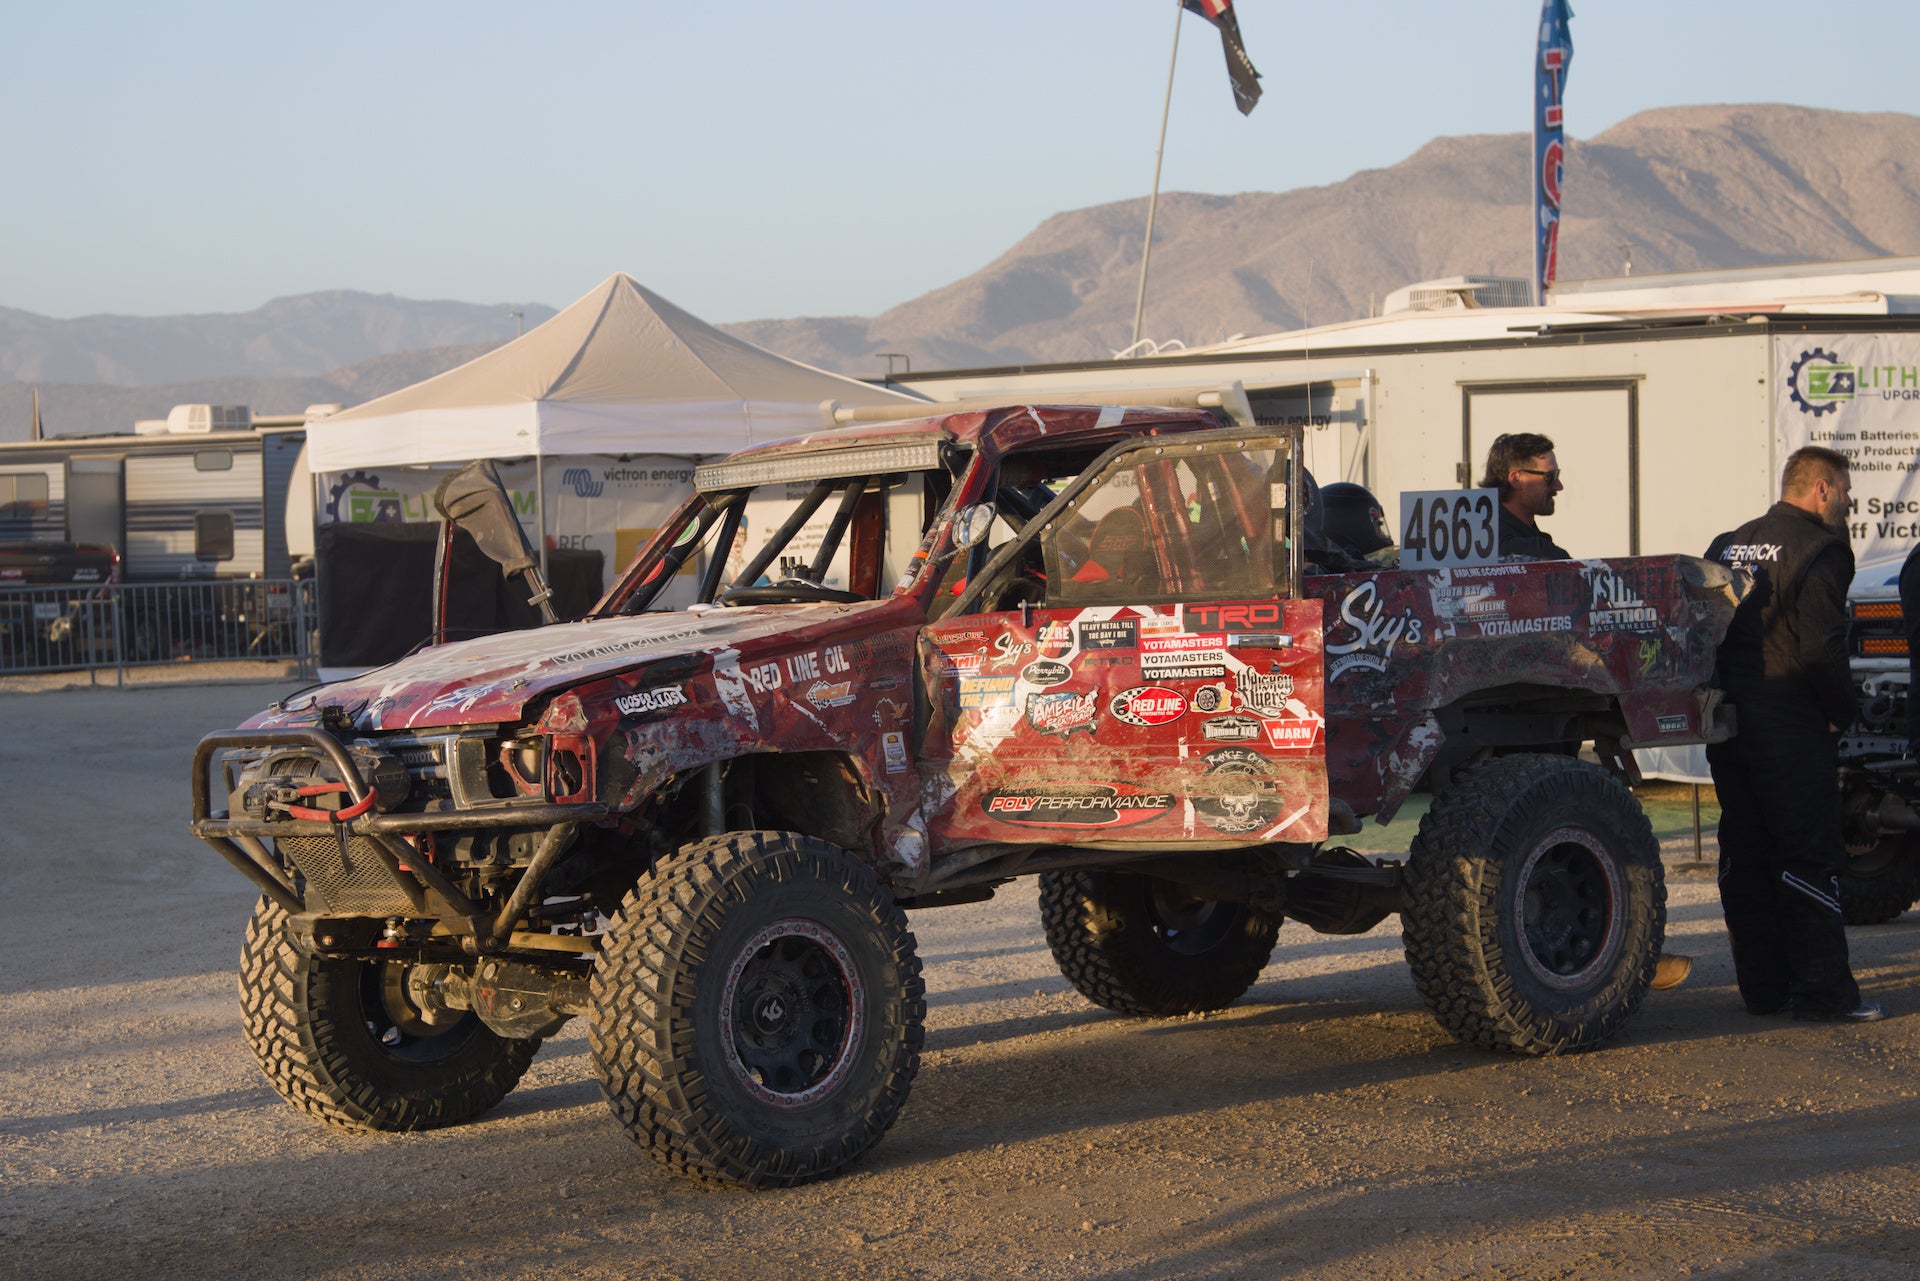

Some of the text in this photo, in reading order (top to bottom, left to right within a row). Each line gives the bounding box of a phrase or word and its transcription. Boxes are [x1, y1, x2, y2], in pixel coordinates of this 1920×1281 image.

[1810, 431, 1919, 441] Lithium Batteries
[1850, 461, 1892, 472] Mobile
[604, 468, 647, 481] victron
[1867, 498, 1918, 518] Spec
[1404, 495, 1494, 561] 4663
[1720, 543, 1783, 561] HERRICK
[1436, 584, 1480, 598] SOUTH BAY
[1465, 600, 1506, 613] DRIVELINE
[1189, 604, 1280, 629] TRD
[1326, 580, 1422, 657] Sky's
[1589, 608, 1657, 625] METHOD
[1081, 621, 1134, 631] HEAVY METAL TILL
[1480, 615, 1572, 636] YOTAMASTERS
[1619, 622, 1657, 631] WHEELS
[1039, 626, 1070, 640] 22RE
[1088, 632, 1099, 640] THE
[1100, 632, 1113, 640] DAY
[990, 632, 1032, 665] Sky's
[1053, 640, 1073, 649] Works
[1143, 637, 1223, 650] YOTAMASTERS
[1143, 652, 1223, 664] YOTAMASTERS
[750, 663, 782, 694] RED
[786, 652, 821, 683] LINE
[824, 645, 850, 674] OIL
[1143, 667, 1225, 679] YOTAMASTERS
[960, 677, 1015, 692] DEFUND
[1033, 694, 1095, 724] AMERICA
[1133, 698, 1183, 711] RED LINE
[1206, 724, 1258, 738] Diamond Axle
[1272, 728, 1311, 739] WARN
[402, 751, 439, 764] TOYOTA
